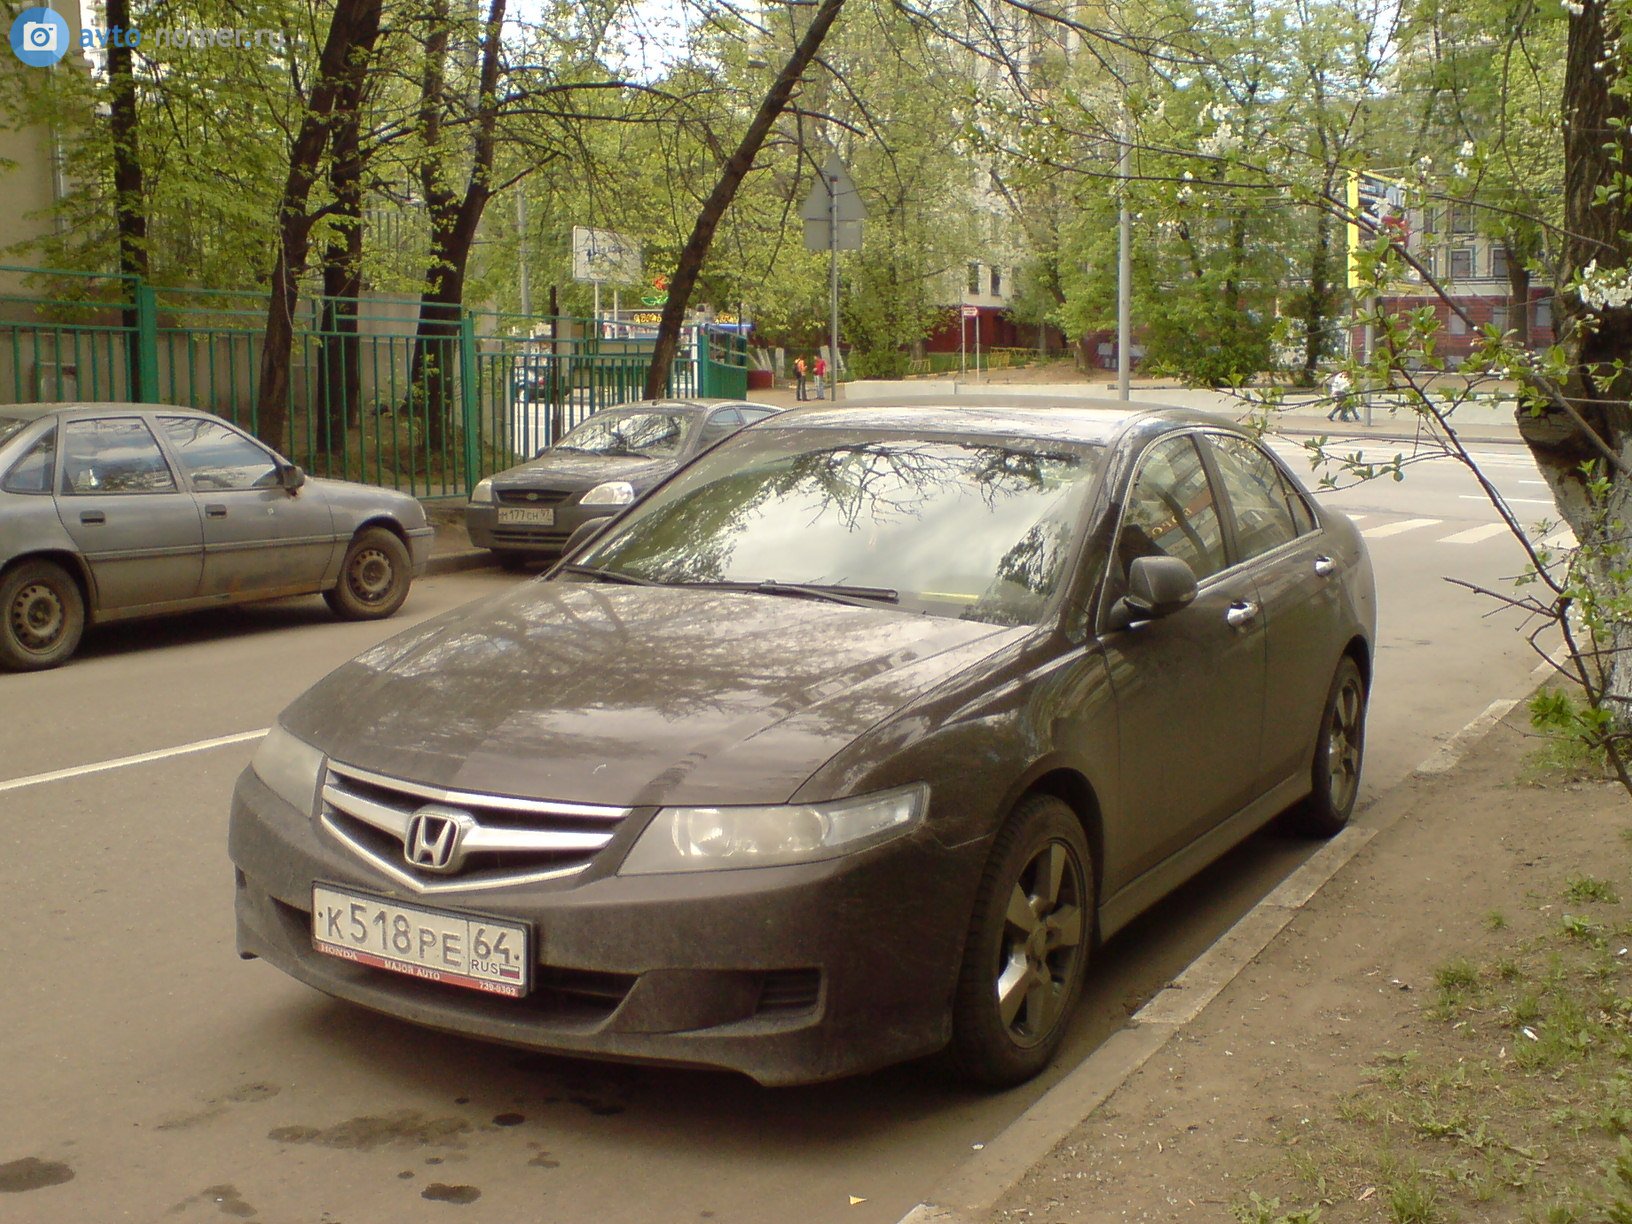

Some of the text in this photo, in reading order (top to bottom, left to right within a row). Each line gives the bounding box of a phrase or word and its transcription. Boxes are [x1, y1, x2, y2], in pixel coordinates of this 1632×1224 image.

[320, 944, 358, 961] HONDA
[384, 959, 414, 975] MAJOR
[415, 968, 441, 981] AUTO
[473, 928, 511, 964] 64
[471, 960, 499, 974] RUS
